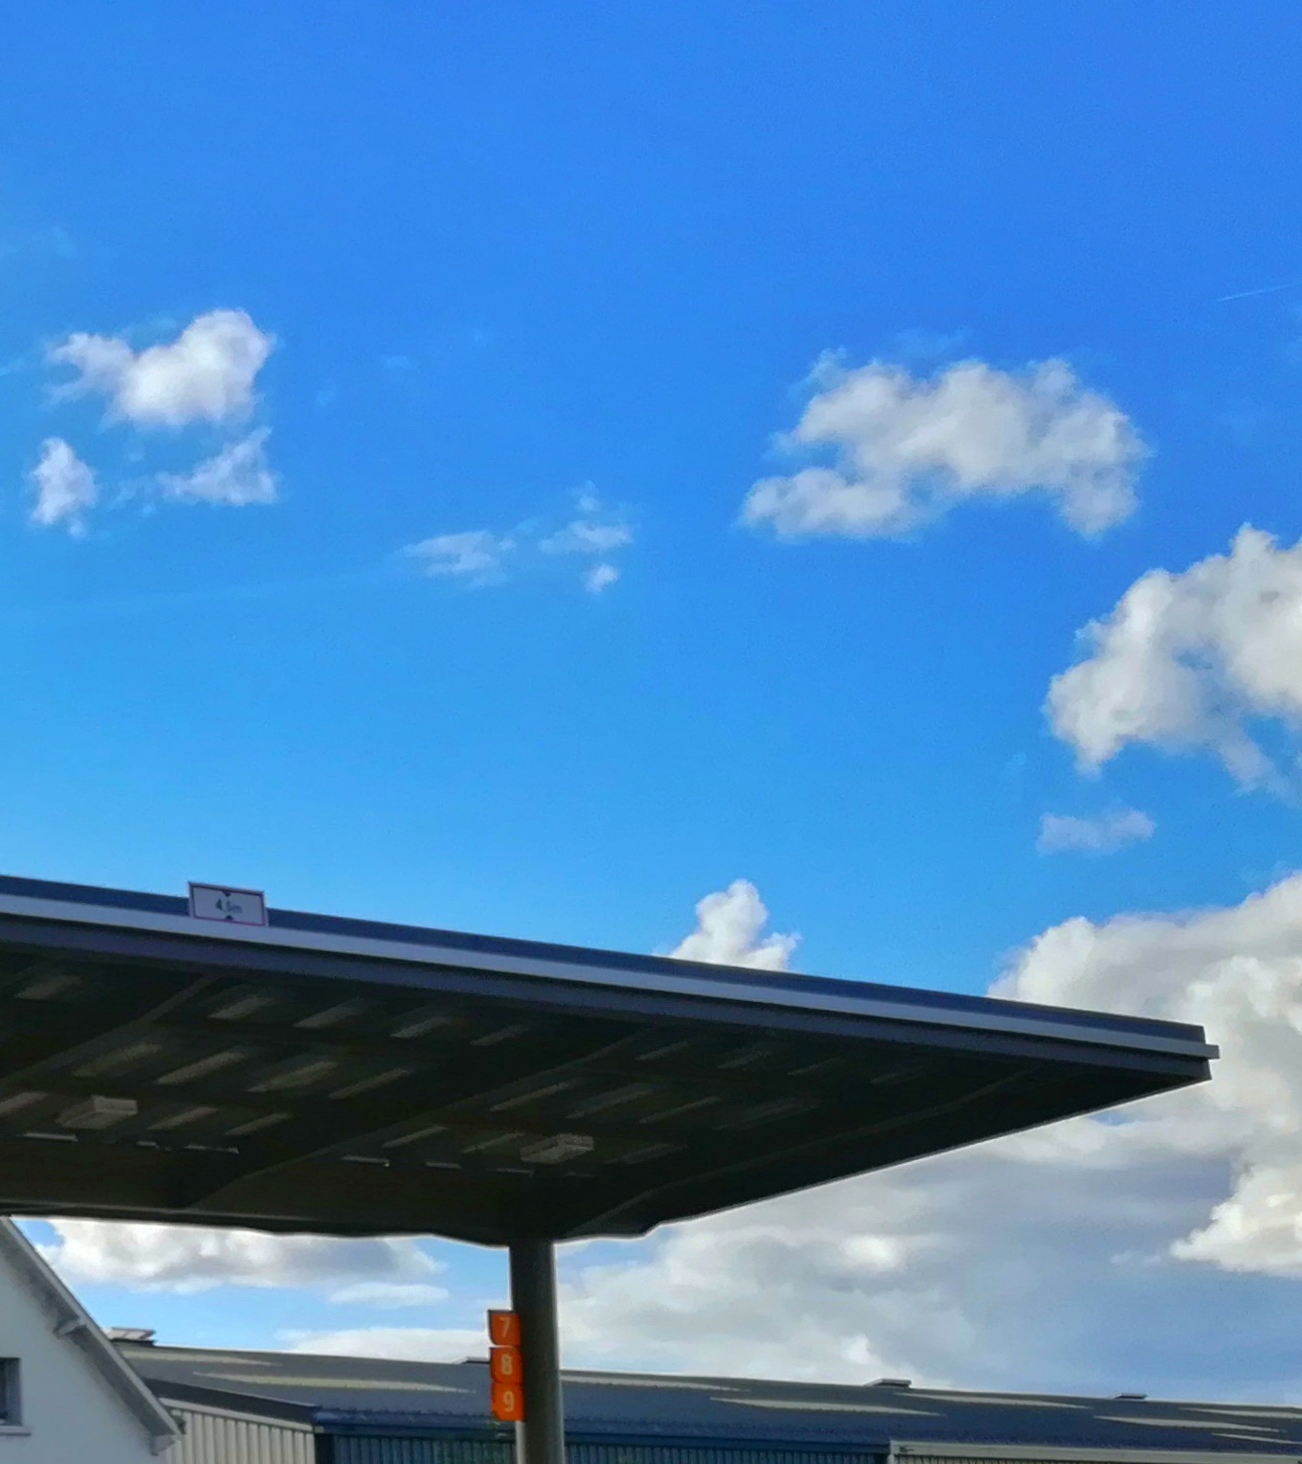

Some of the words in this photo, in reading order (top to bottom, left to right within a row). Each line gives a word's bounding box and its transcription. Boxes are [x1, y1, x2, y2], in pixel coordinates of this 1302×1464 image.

[498, 1316, 511, 1338] 7
[500, 1353, 513, 1376] 8
[502, 1390, 515, 1413] 9
